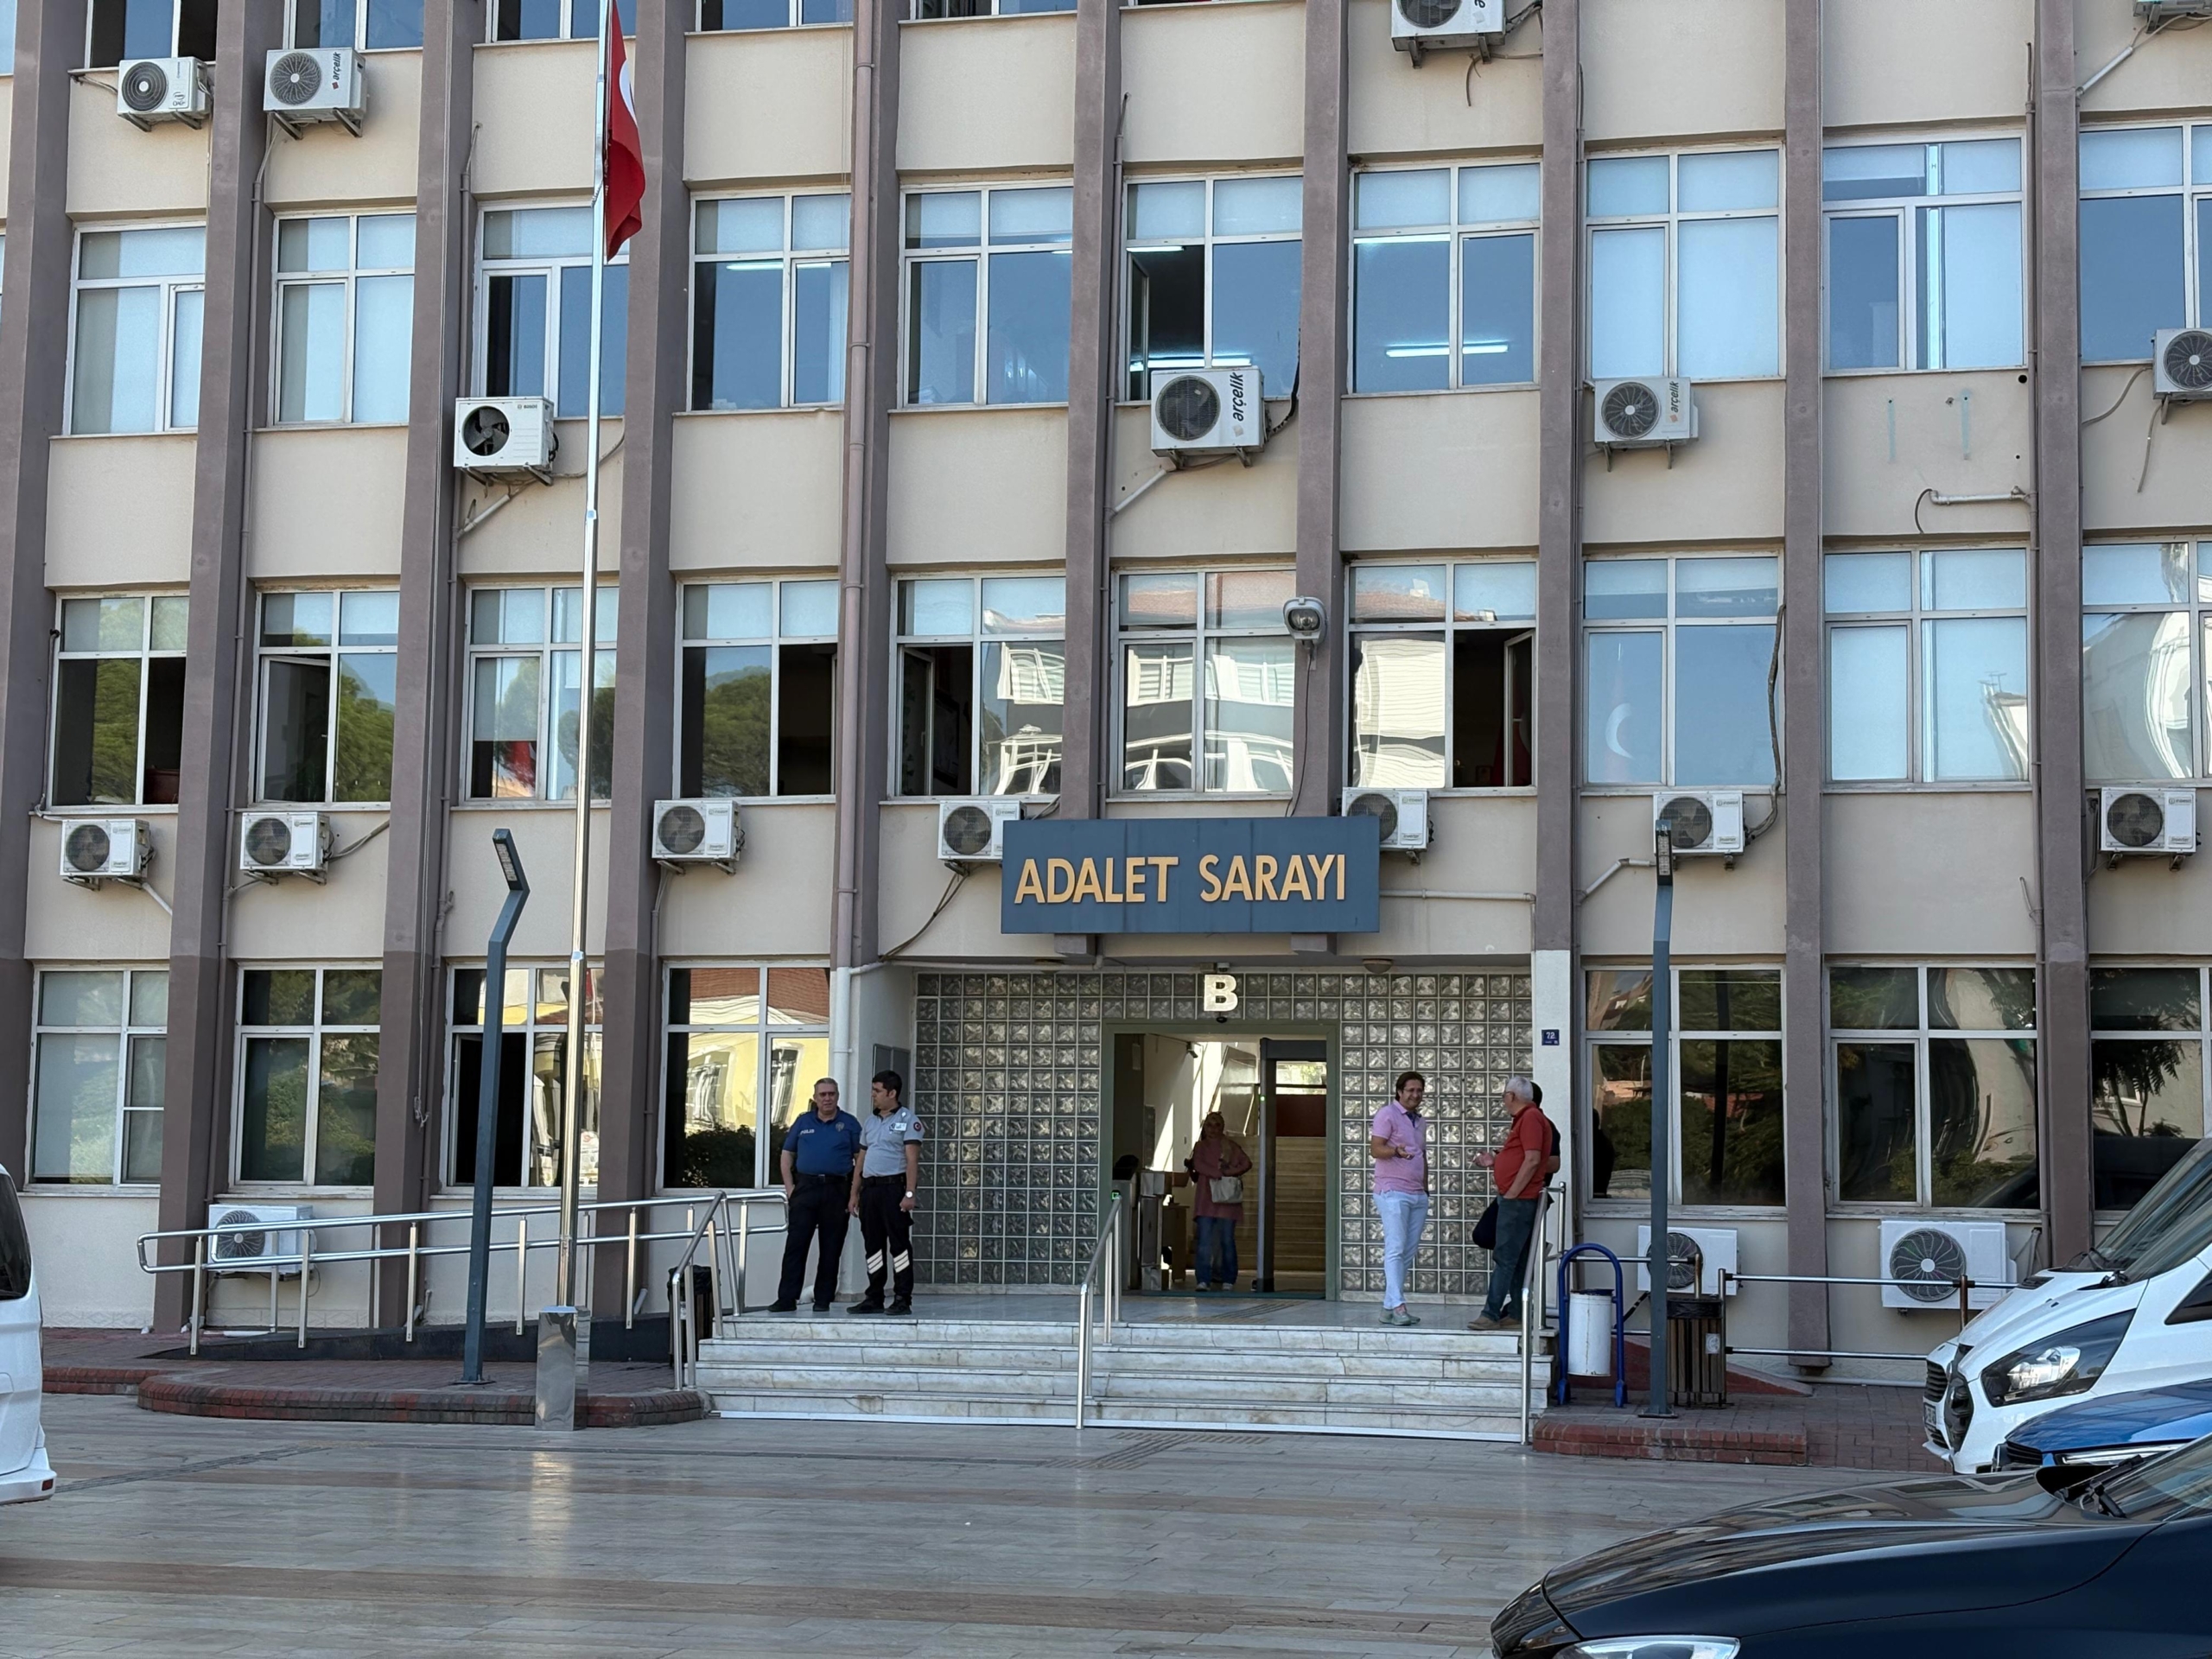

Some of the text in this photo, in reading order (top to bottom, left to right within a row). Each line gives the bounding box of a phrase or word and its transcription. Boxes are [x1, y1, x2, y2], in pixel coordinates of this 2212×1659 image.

[1230, 372, 1247, 422] arçelik
[1669, 381, 1681, 413] arçelik
[1014, 854, 1346, 904] ADALET SARAYI
[1204, 974, 1238, 1011] B
